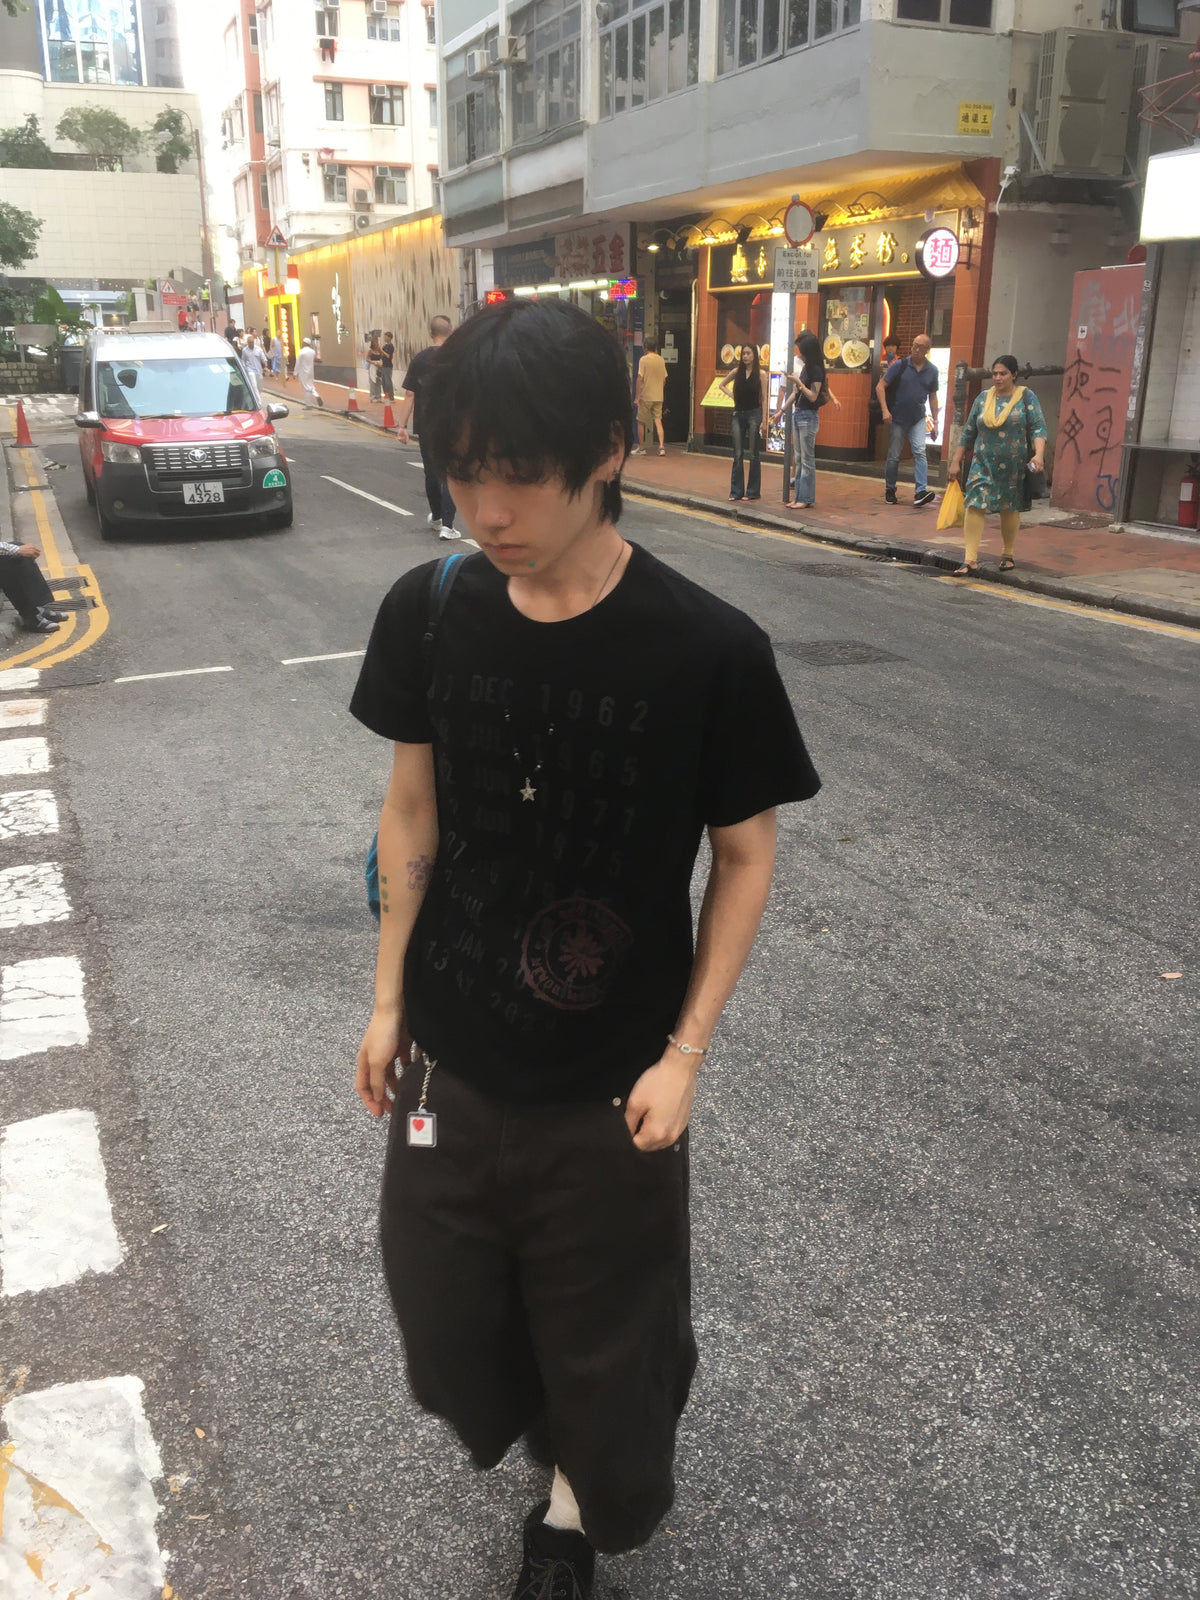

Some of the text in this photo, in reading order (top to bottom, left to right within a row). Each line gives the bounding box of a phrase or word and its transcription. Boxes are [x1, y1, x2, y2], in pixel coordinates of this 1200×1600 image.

[194, 483, 211, 493] KL
[188, 493, 221, 503] 4328
[468, 673, 514, 704] DEC
